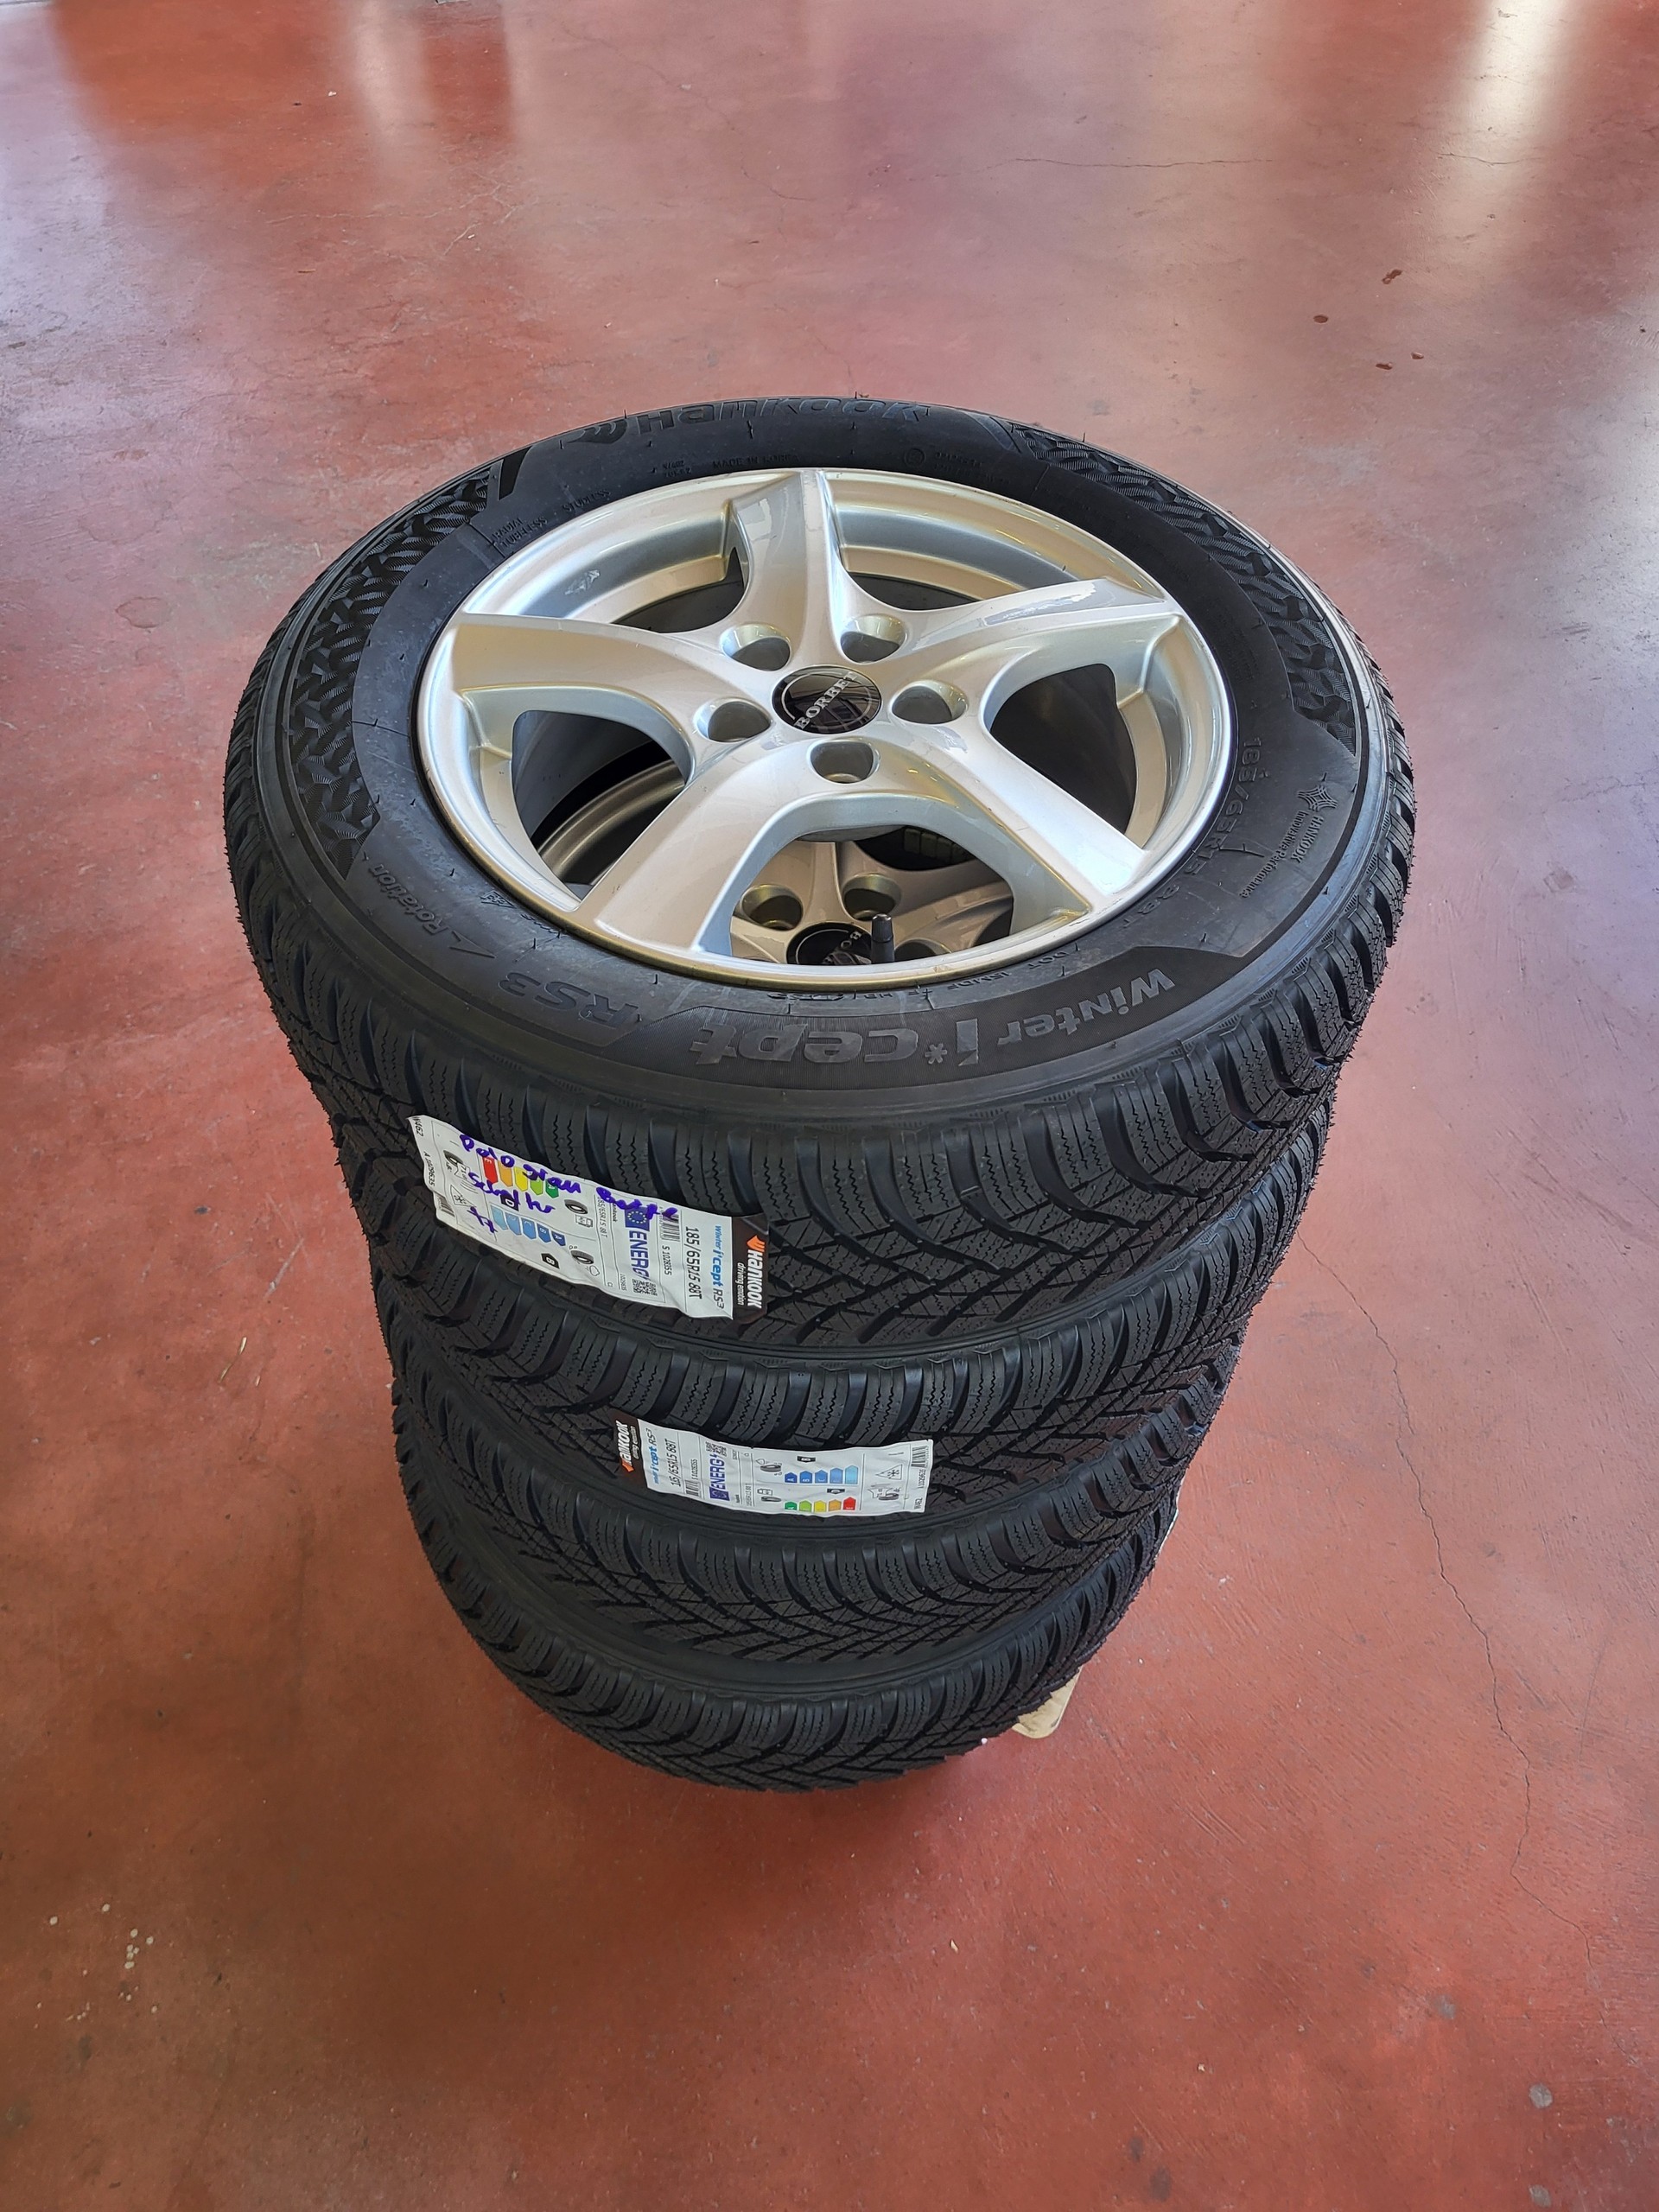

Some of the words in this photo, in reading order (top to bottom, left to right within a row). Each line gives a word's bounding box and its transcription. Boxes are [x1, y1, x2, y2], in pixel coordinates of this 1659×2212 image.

[562, 488, 613, 513] STUDLESS
[493, 517, 527, 540] RADIAL
[500, 517, 549, 550] TUBELESS
[793, 671, 858, 730] BORBET
[1290, 815, 1324, 865] HANKOOK
[369, 862, 447, 938] Rotation
[1028, 950, 1071, 969] DOT
[499, 972, 639, 1029] RS3
[995, 969, 1176, 1045] Winter
[683, 1225, 702, 1282] 185/65R15
[735, 1262, 747, 1284] driving
[688, 1282, 702, 1300] 88T
[737, 1284, 746, 1306] emotion
[709, 1458, 726, 1490] ENERG
